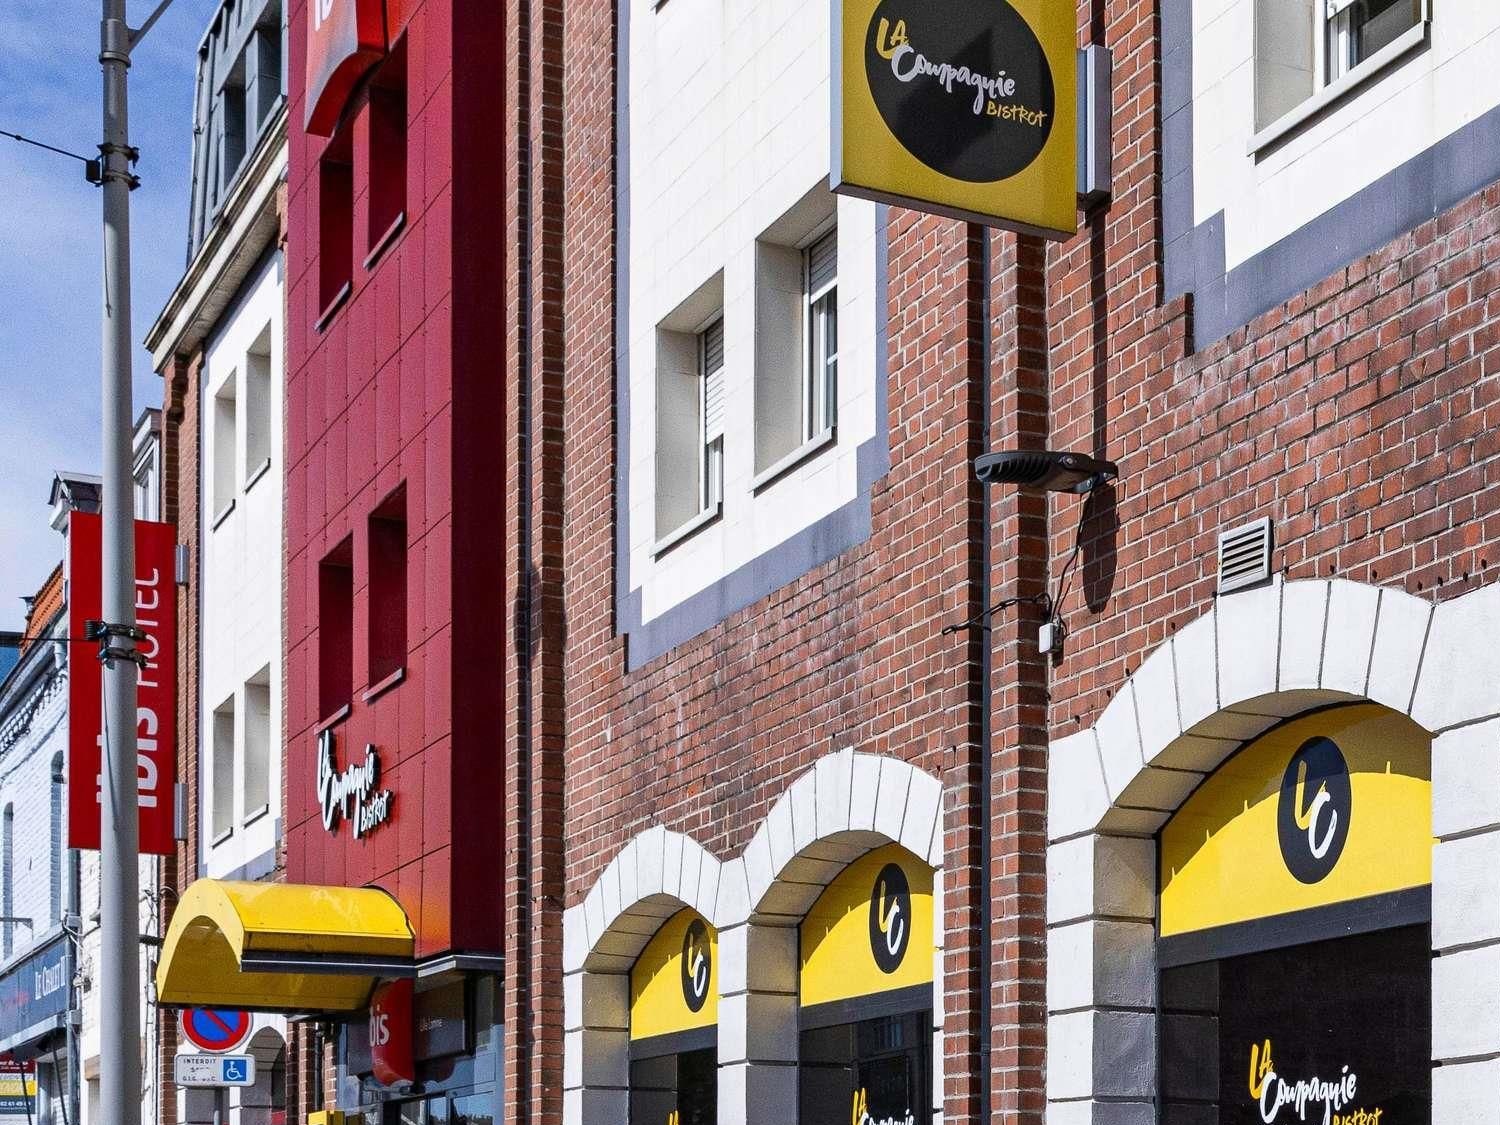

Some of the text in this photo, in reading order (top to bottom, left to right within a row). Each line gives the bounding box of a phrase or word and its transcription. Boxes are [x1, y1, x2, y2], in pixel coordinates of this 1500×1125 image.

[875, 17, 909, 60] LA
[891, 45, 1015, 115] Compagnie
[986, 100, 1047, 127] BISTROT
[1249, 1039, 1274, 1099] LA
